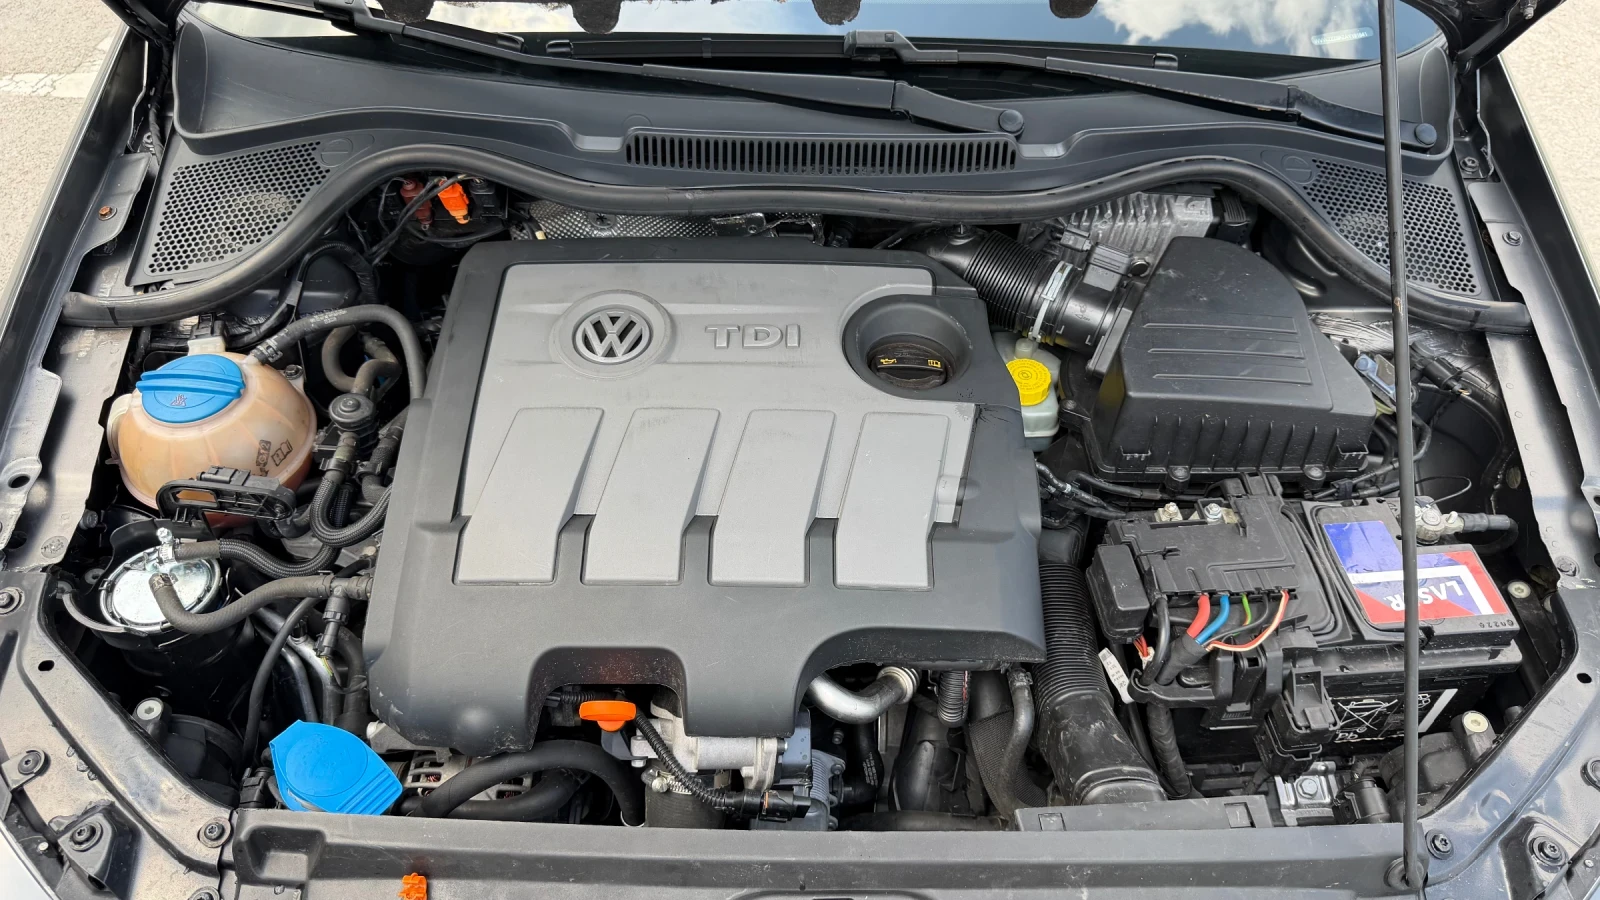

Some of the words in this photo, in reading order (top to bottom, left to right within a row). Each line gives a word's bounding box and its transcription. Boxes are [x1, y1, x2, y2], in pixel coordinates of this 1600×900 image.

[577, 309, 649, 362] VW
[705, 324, 801, 349] TDI
[1384, 580, 1464, 612] LASR
